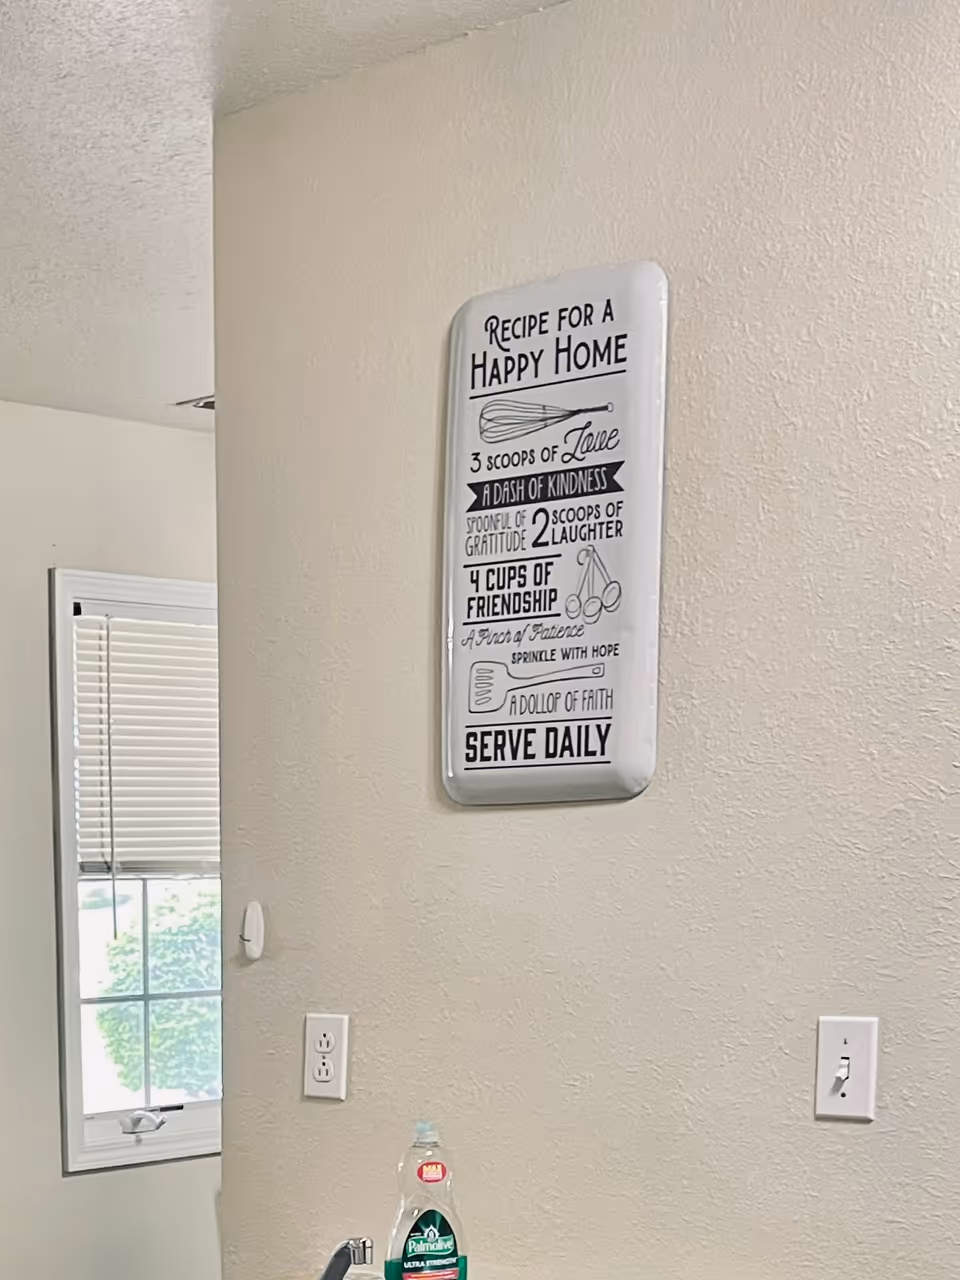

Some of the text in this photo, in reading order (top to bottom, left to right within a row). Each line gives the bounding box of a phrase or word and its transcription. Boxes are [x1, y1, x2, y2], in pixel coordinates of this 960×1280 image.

[557, 303, 594, 331] FOR
[601, 299, 615, 323] A
[470, 421, 620, 473] 3 SCOOPS OF Love
[482, 467, 608, 506] A DASH OF KINDNESS
[466, 509, 527, 535] SPOONFUL OF
[551, 501, 624, 525] SCOOPS OF
[531, 508, 550, 548] 2
[551, 520, 624, 545] LAUGHTER
[465, 529, 527, 557] GRATITUDE
[470, 561, 554, 593] 4 CUPS OF
[467, 588, 558, 619] FRIENDSHIP
[461, 623, 585, 649] A Pinch of Patience
[511, 643, 620, 664] SPRINKLE WITH HOPE
[509, 688, 613, 716] A DOLLOP OF FAITH
[465, 724, 612, 763] SERVE DAILY
[408, 1239, 453, 1253] Palmolive
[404, 1261, 425, 1269] ULTRA
